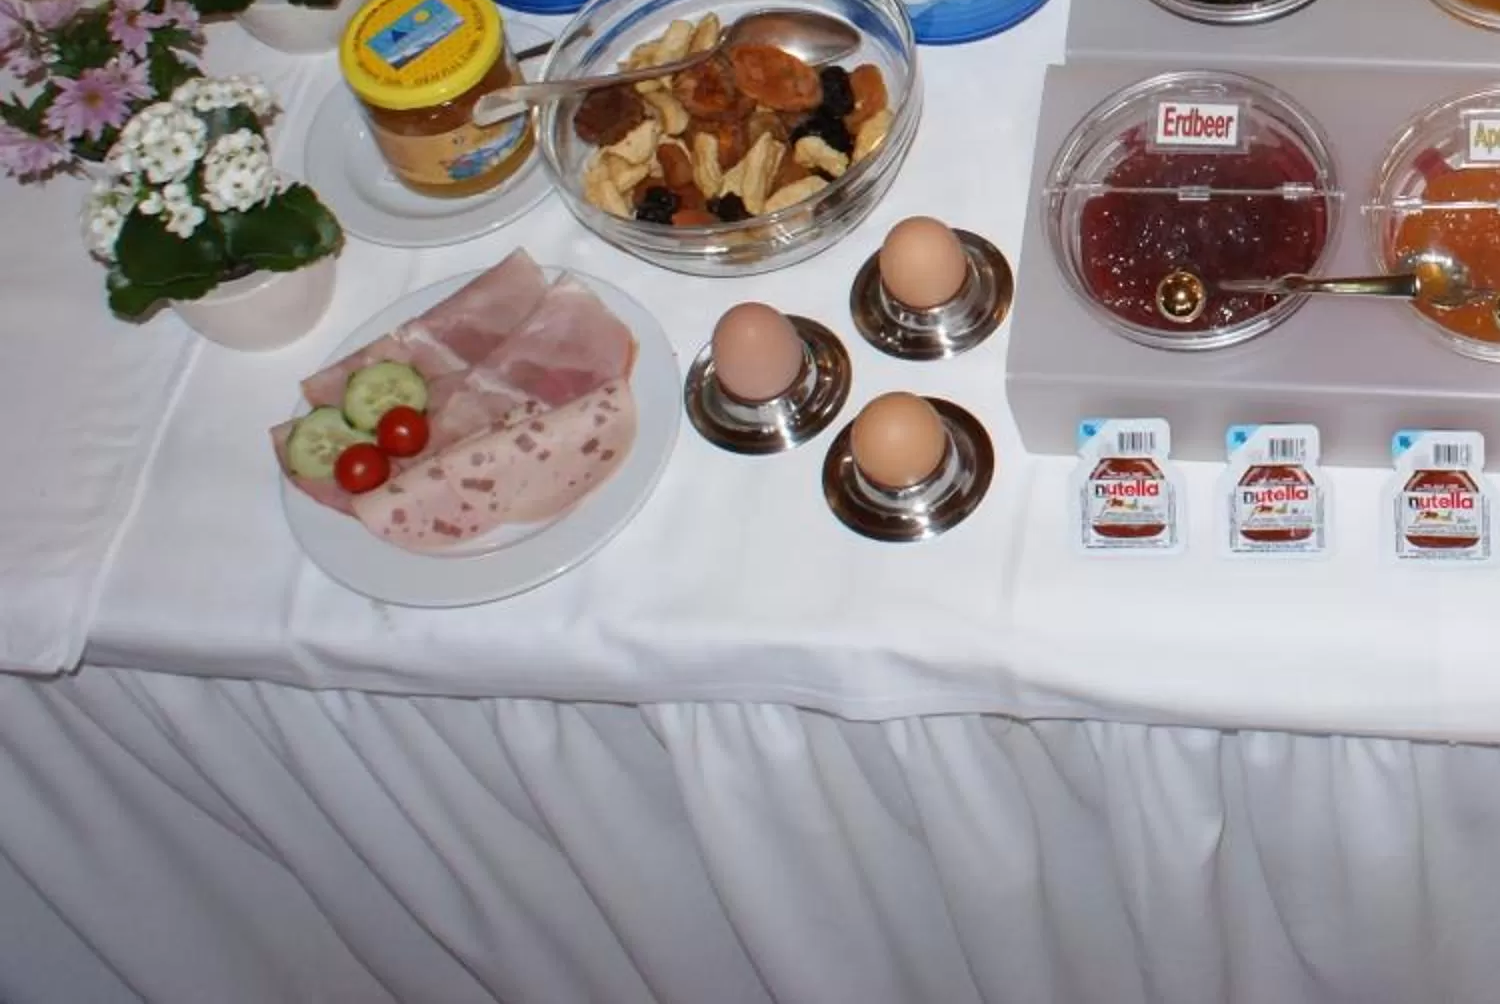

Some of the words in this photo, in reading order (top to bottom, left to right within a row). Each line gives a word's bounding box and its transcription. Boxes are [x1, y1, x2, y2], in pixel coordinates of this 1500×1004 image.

[1163, 106, 1235, 138] Erdbeer
[1095, 479, 1160, 497] nutella
[1243, 484, 1309, 504] nutella
[1408, 491, 1473, 510] nutella
